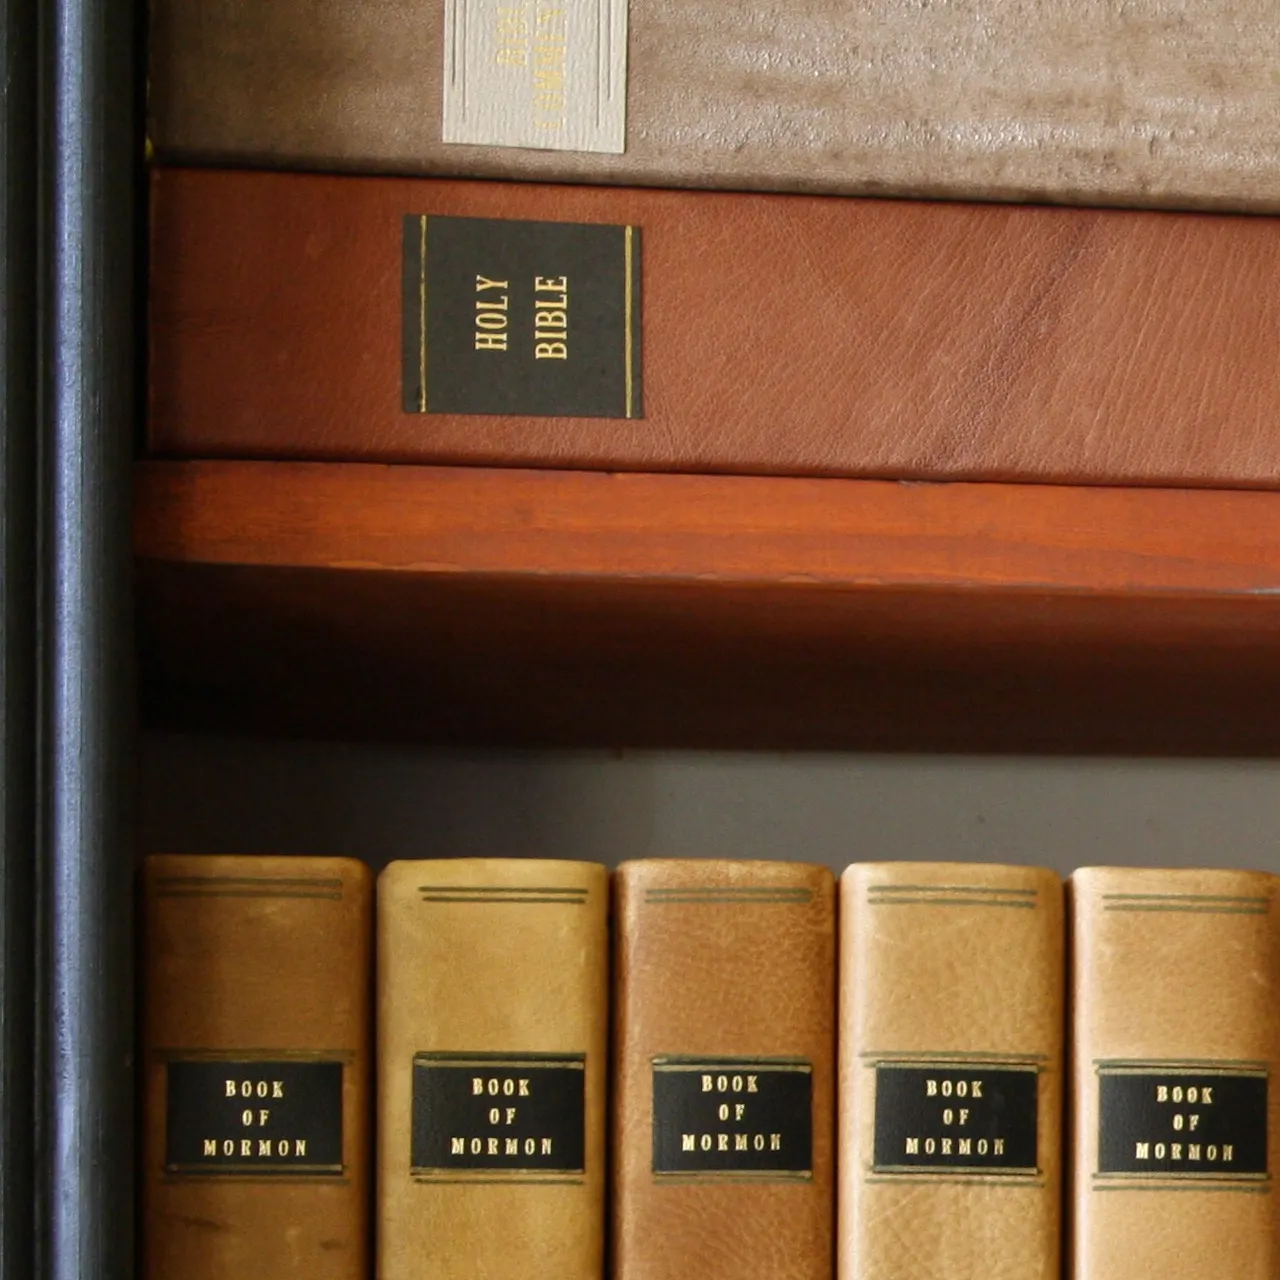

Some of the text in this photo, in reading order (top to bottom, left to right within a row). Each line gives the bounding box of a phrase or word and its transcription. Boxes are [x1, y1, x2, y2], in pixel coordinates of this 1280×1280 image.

[474, 274, 509, 351] HOLY
[534, 276, 568, 360] BIBLE
[225, 1079, 283, 1098] BOOK
[472, 1077, 529, 1097] BOOK
[701, 1074, 758, 1093] BOOK
[926, 1079, 982, 1098] BOOK
[1156, 1085, 1212, 1104] BOOK
[241, 1109, 269, 1126] OF
[488, 1107, 516, 1125] OF
[718, 1103, 745, 1121] OF
[942, 1108, 969, 1125] OF
[1172, 1114, 1199, 1131] OF
[204, 1139, 306, 1157] MORMON
[451, 1137, 552, 1156] MORMON
[681, 1133, 780, 1152] MORMON
[905, 1137, 1004, 1155] MORMON
[1135, 1141, 1233, 1161] MORMON
